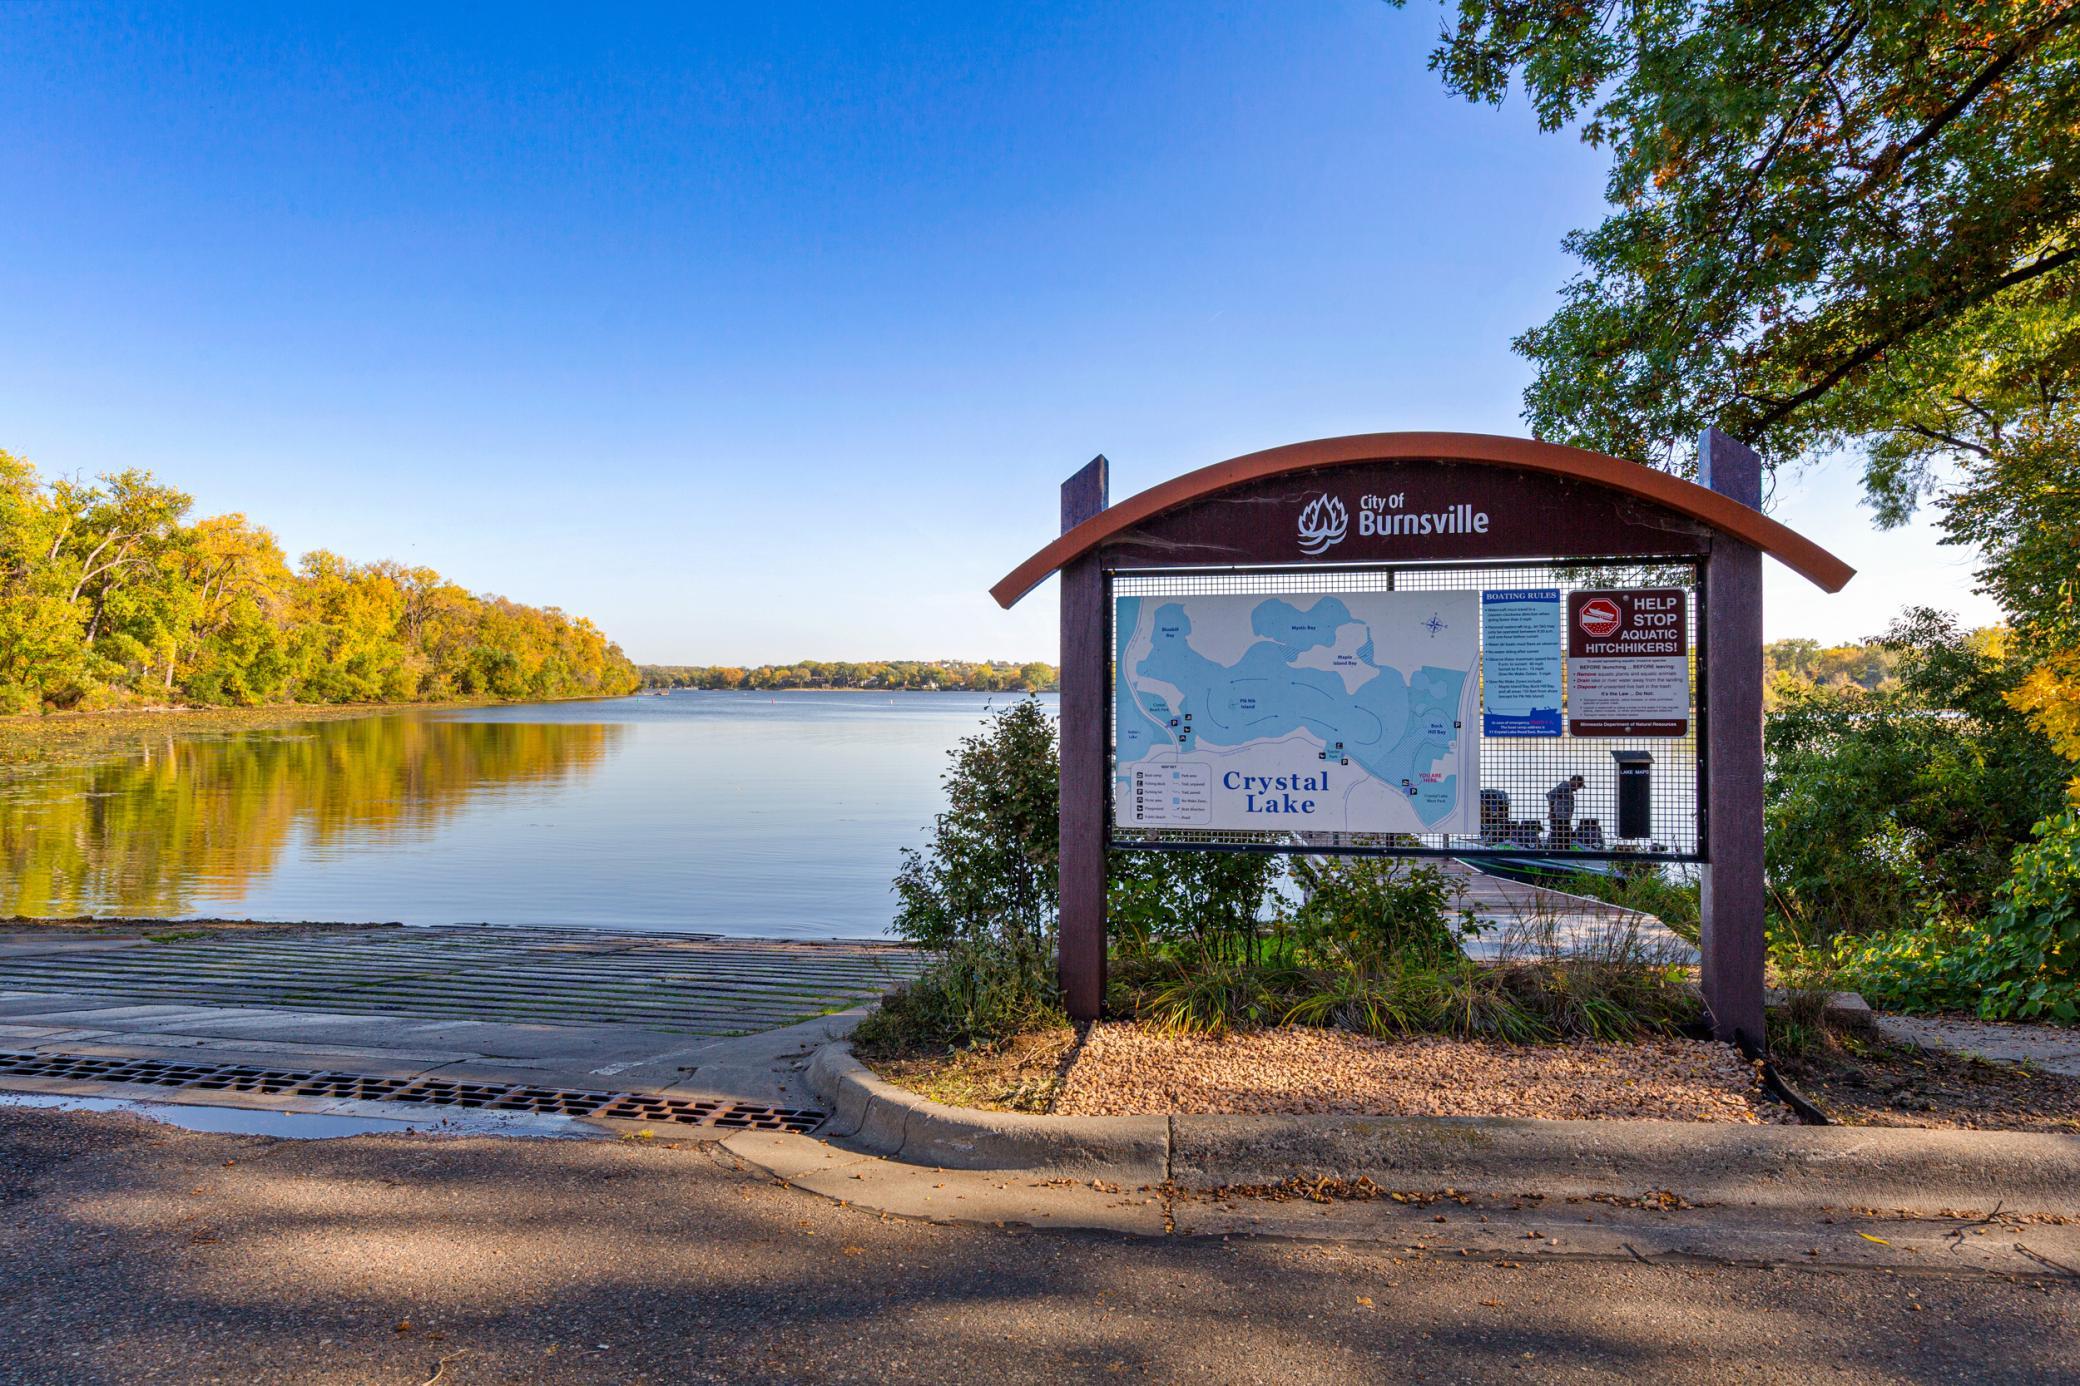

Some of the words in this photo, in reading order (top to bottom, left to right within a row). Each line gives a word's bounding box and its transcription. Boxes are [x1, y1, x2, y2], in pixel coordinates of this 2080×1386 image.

[1360, 494, 1386, 513] City
[1389, 492, 1404, 508] Of
[1359, 504, 1489, 536] Burnsville
[1634, 598, 1677, 610] HELP
[1634, 614, 1677, 626] STOP
[1620, 630, 1677, 640] AQUATIC
[1586, 642, 1678, 653] HITCHHIKERS!
[1223, 771, 1329, 795] Crystal
[1246, 794, 1316, 814] Lake
